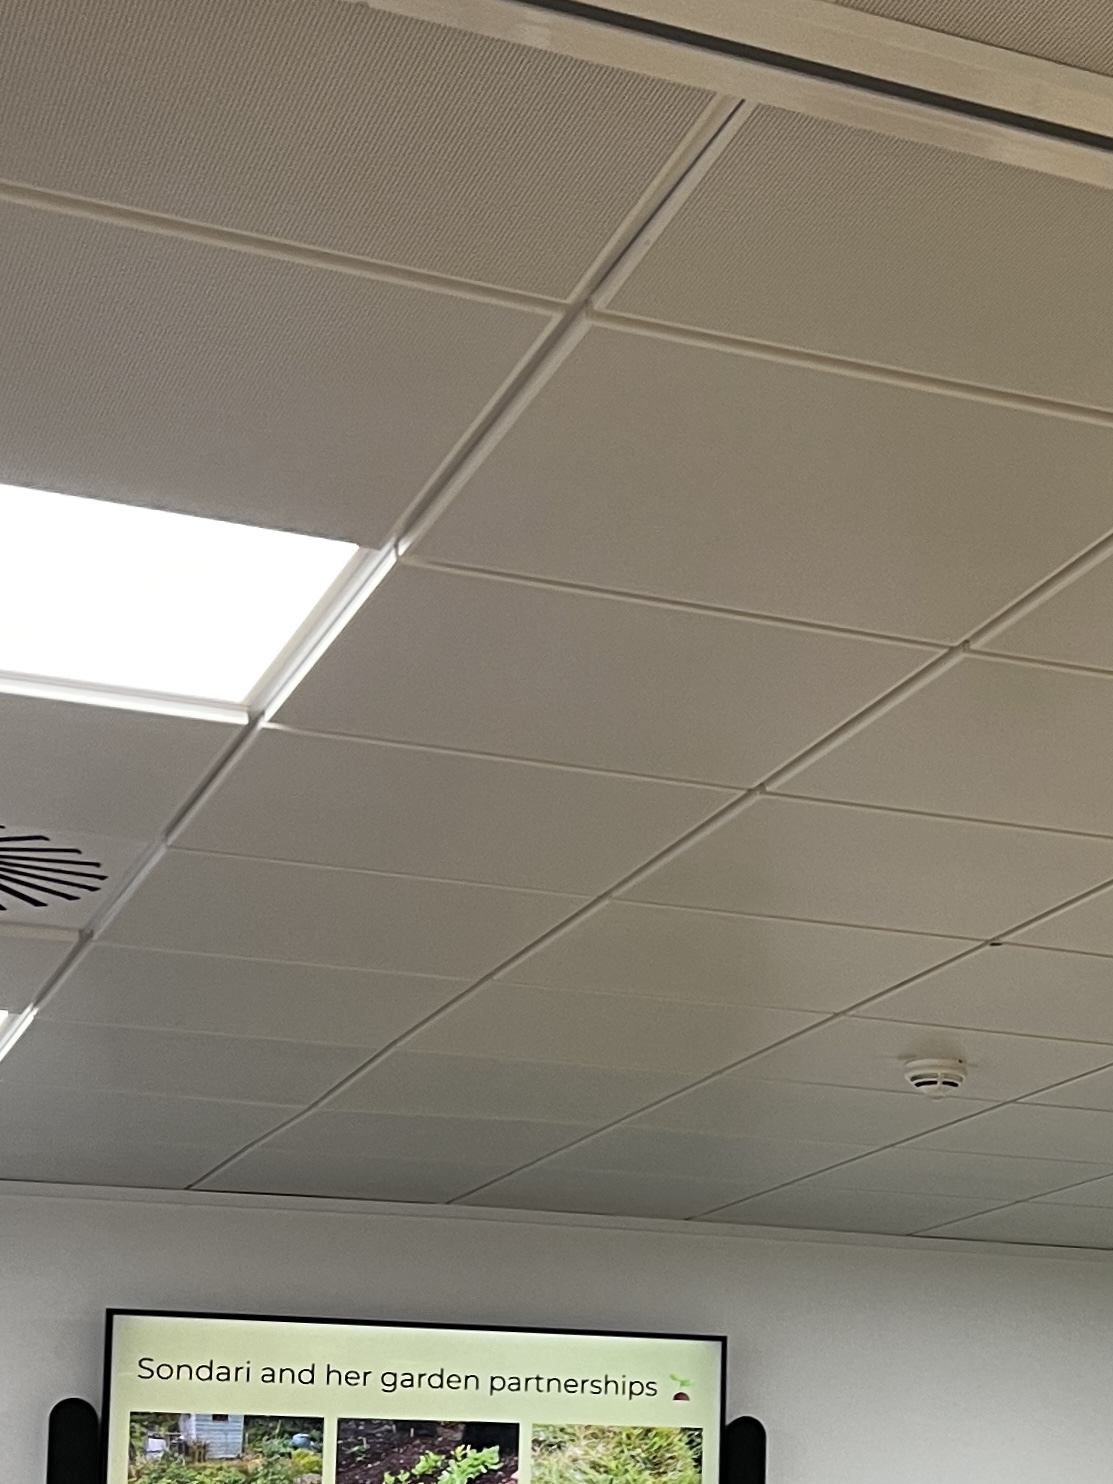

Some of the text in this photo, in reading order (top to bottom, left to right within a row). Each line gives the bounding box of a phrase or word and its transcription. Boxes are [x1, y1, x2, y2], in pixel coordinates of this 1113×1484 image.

[137, 1357, 659, 1401] Sondari and her garden partnerships
